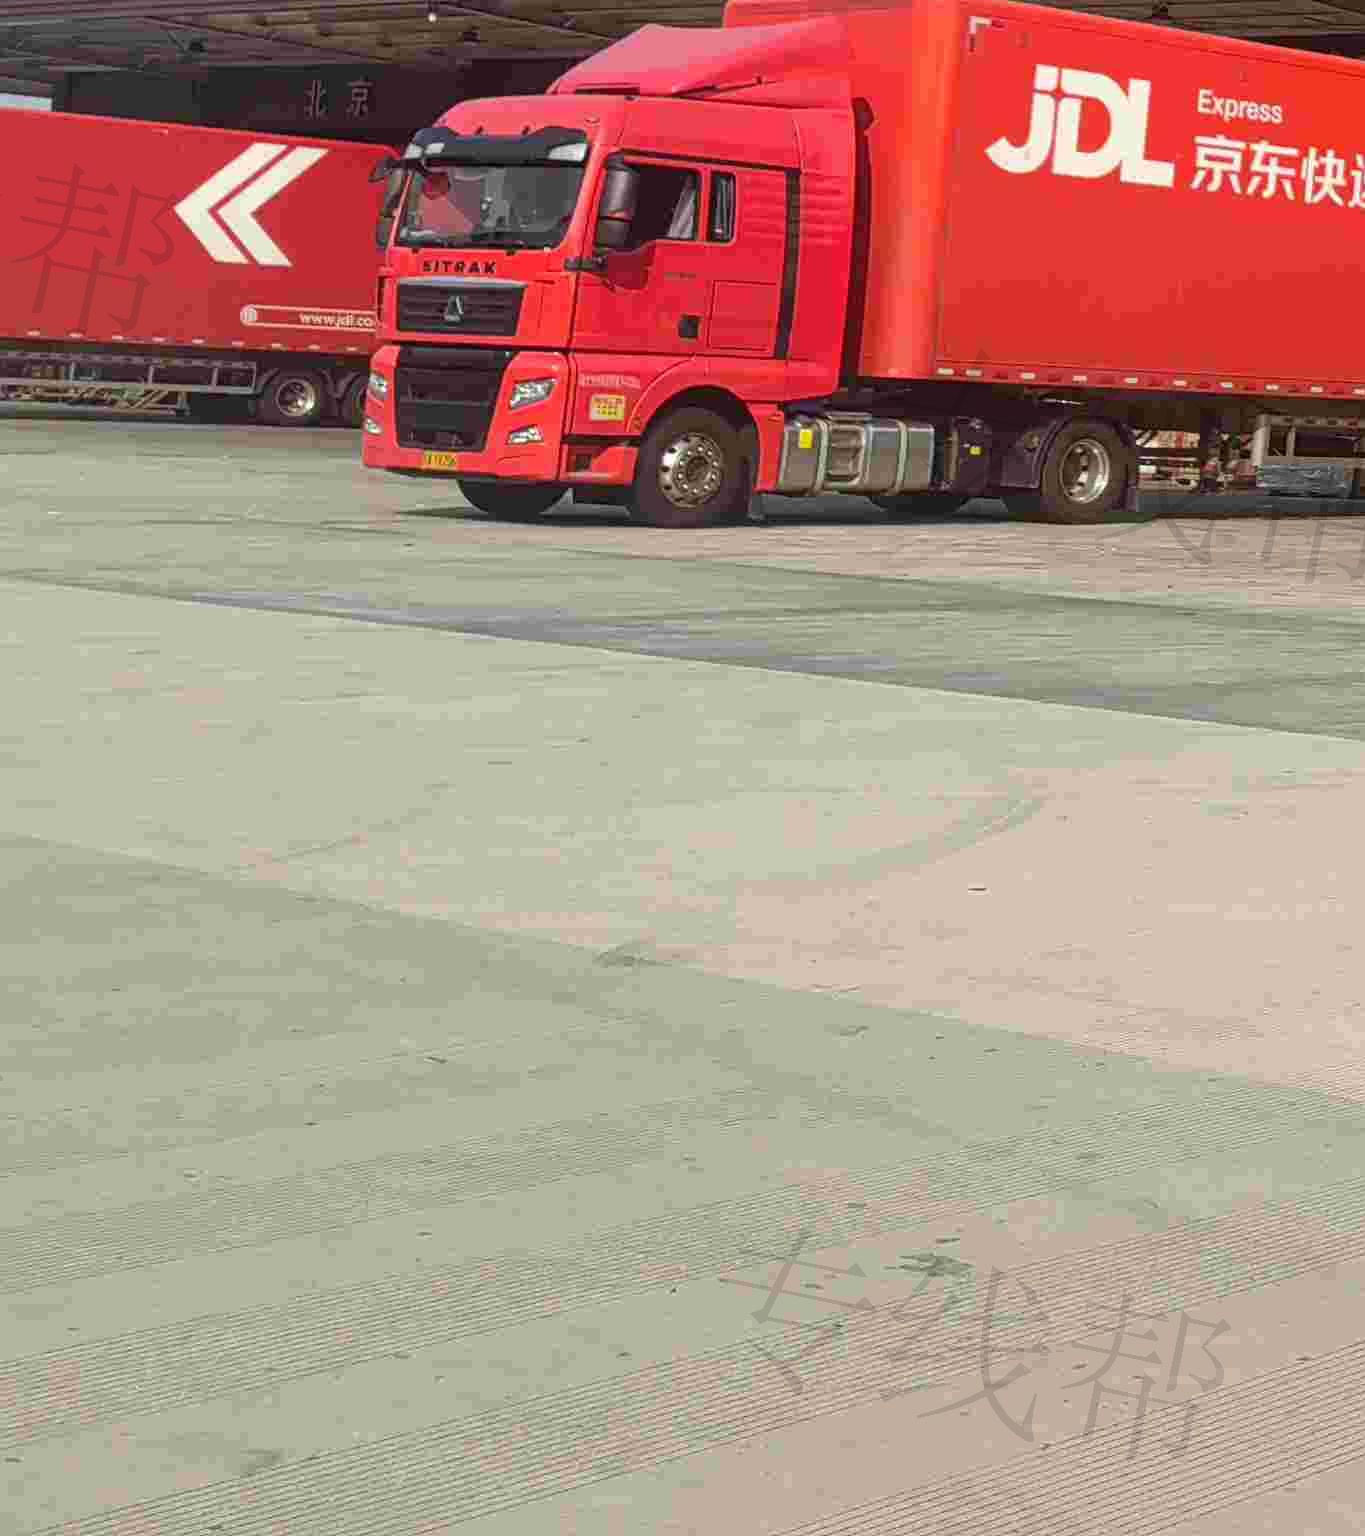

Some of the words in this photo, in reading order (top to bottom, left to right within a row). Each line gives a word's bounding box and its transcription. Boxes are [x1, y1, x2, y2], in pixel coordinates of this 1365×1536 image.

[303, 72, 374, 120] 北京
[1196, 88, 1284, 125] Express
[984, 64, 1175, 188] JDL
[423, 260, 497, 274] SITRAK
